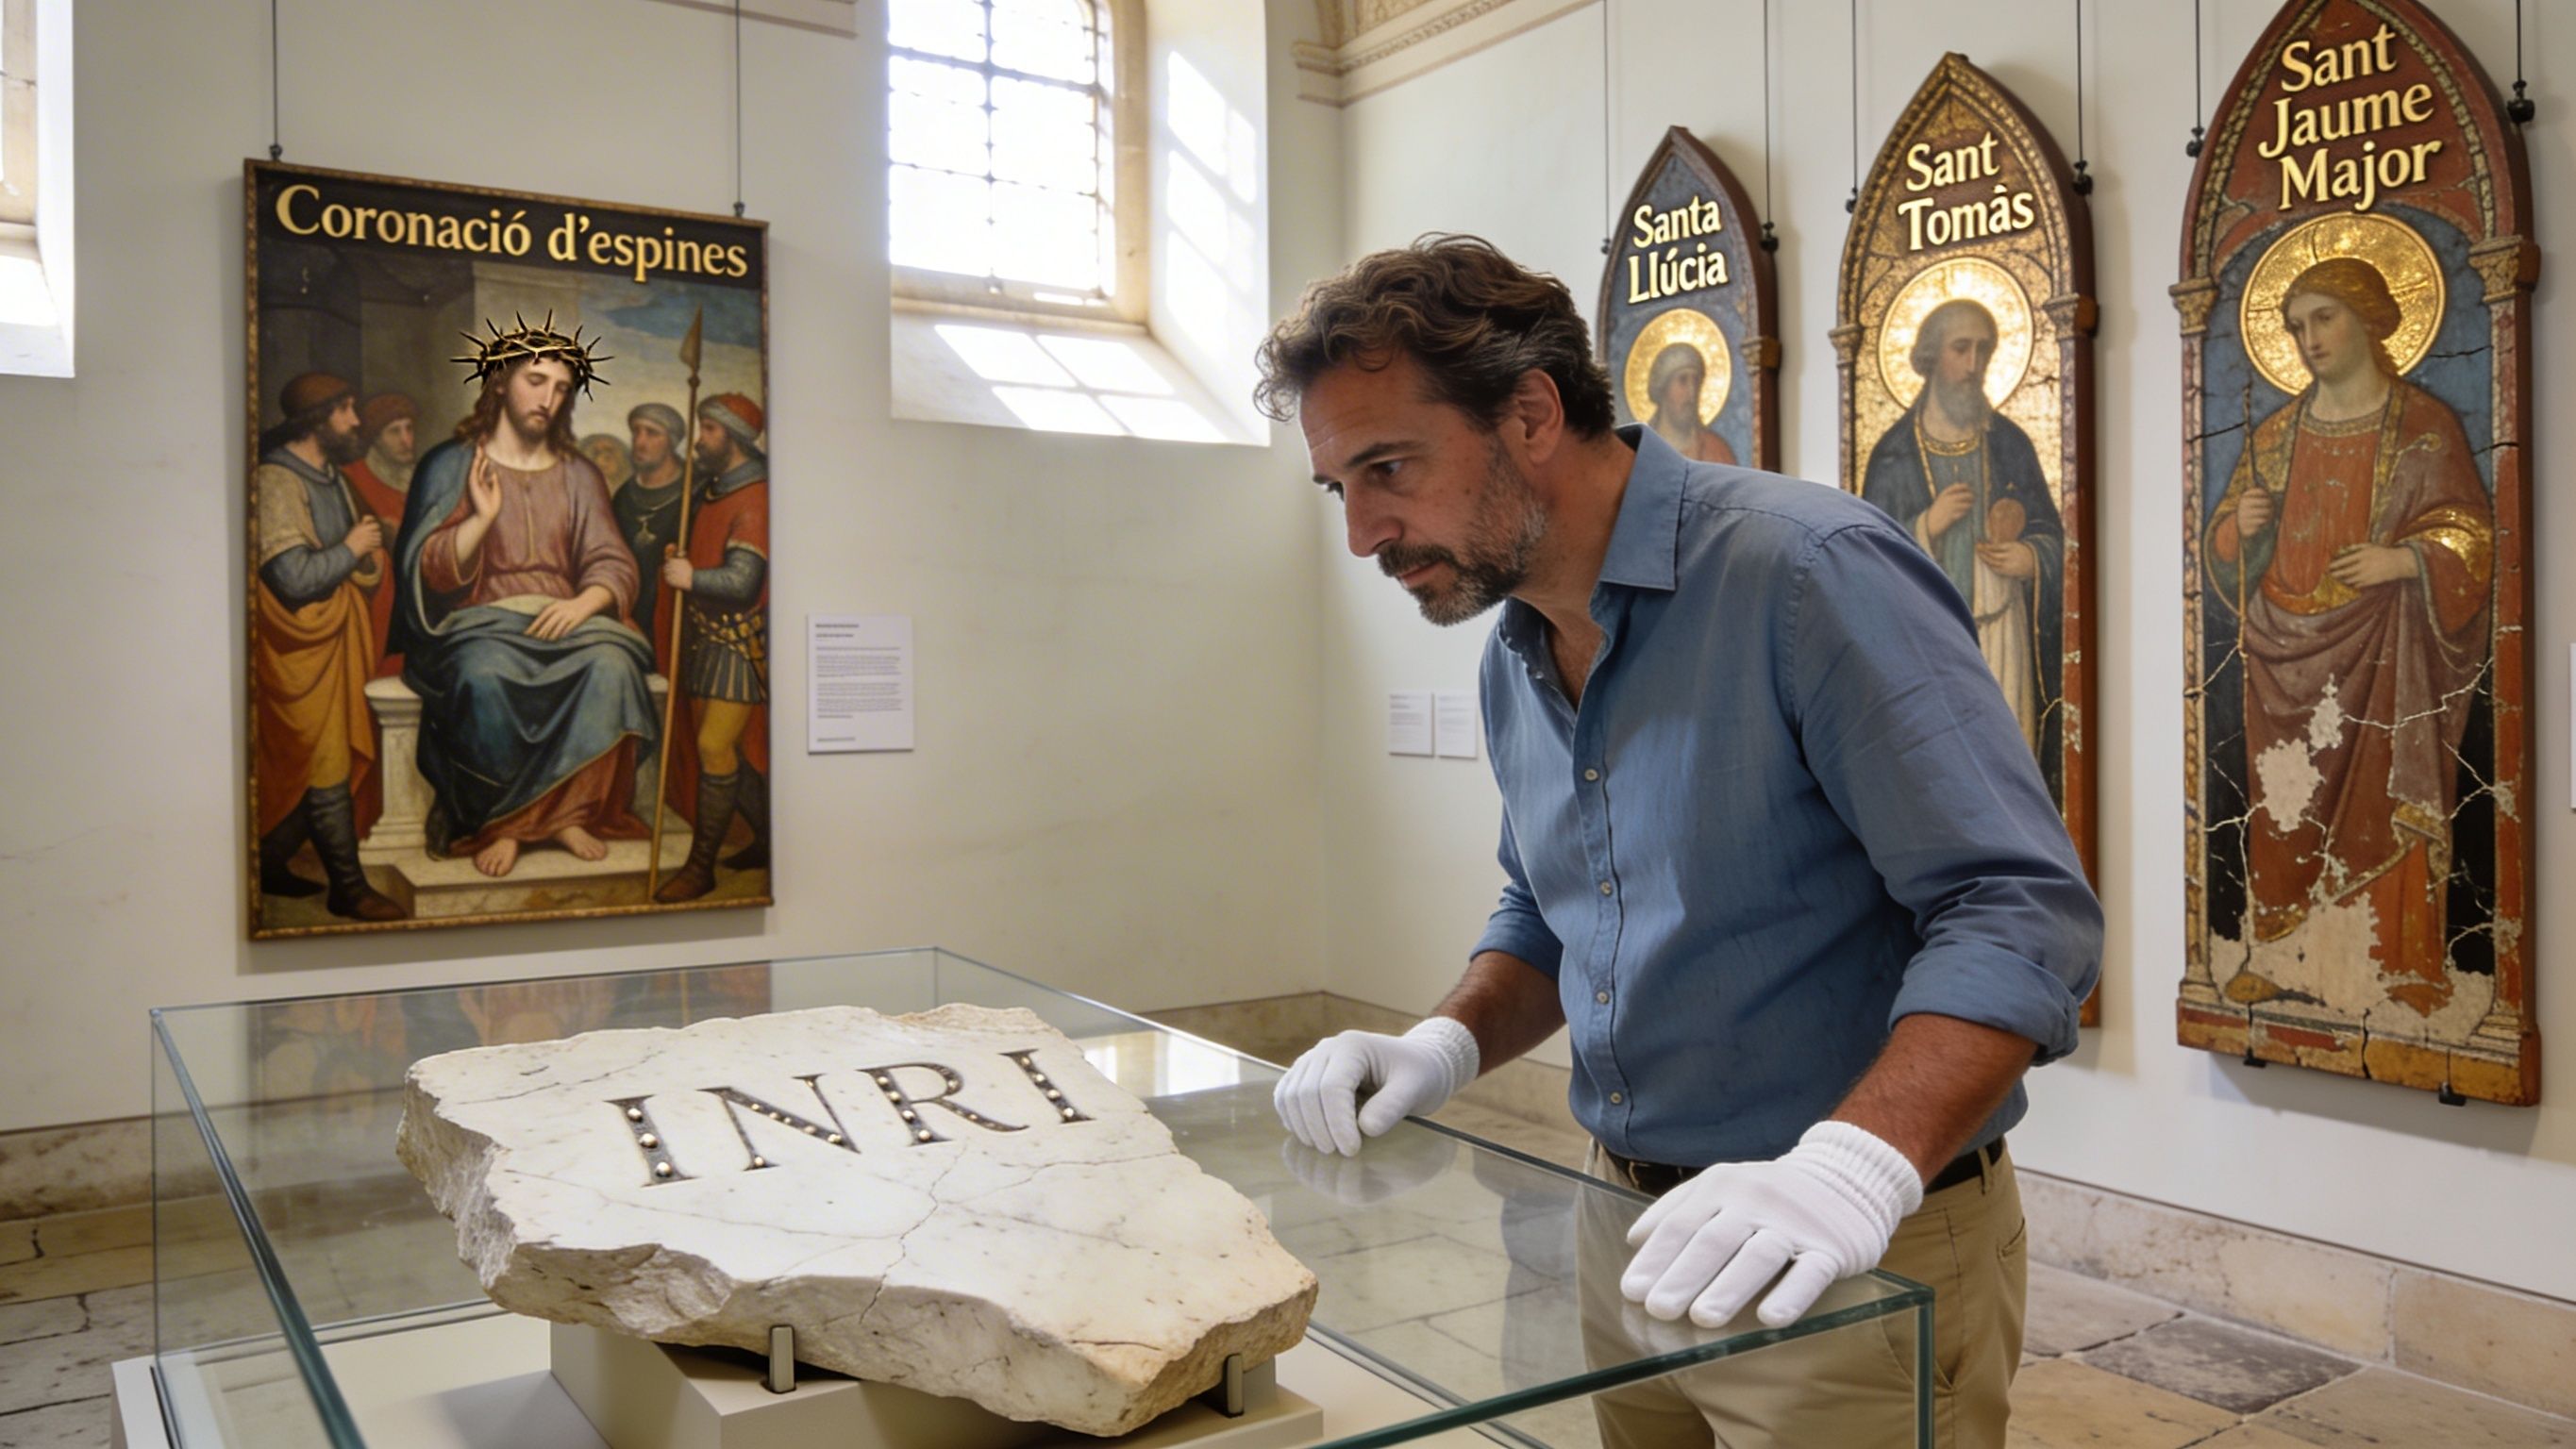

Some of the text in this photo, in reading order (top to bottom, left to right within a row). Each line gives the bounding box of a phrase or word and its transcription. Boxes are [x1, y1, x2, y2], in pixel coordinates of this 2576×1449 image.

[2280, 23, 2398, 92] Sant
[2258, 83, 2434, 158] Jaume
[1905, 130, 2001, 192] Sant
[2278, 141, 2443, 211] Major
[276, 184, 749, 283] Coronació d'espines
[1632, 194, 1722, 249] Santa
[1627, 242, 1729, 305] Llúcia
[603, 1048, 1096, 1188] INRI
